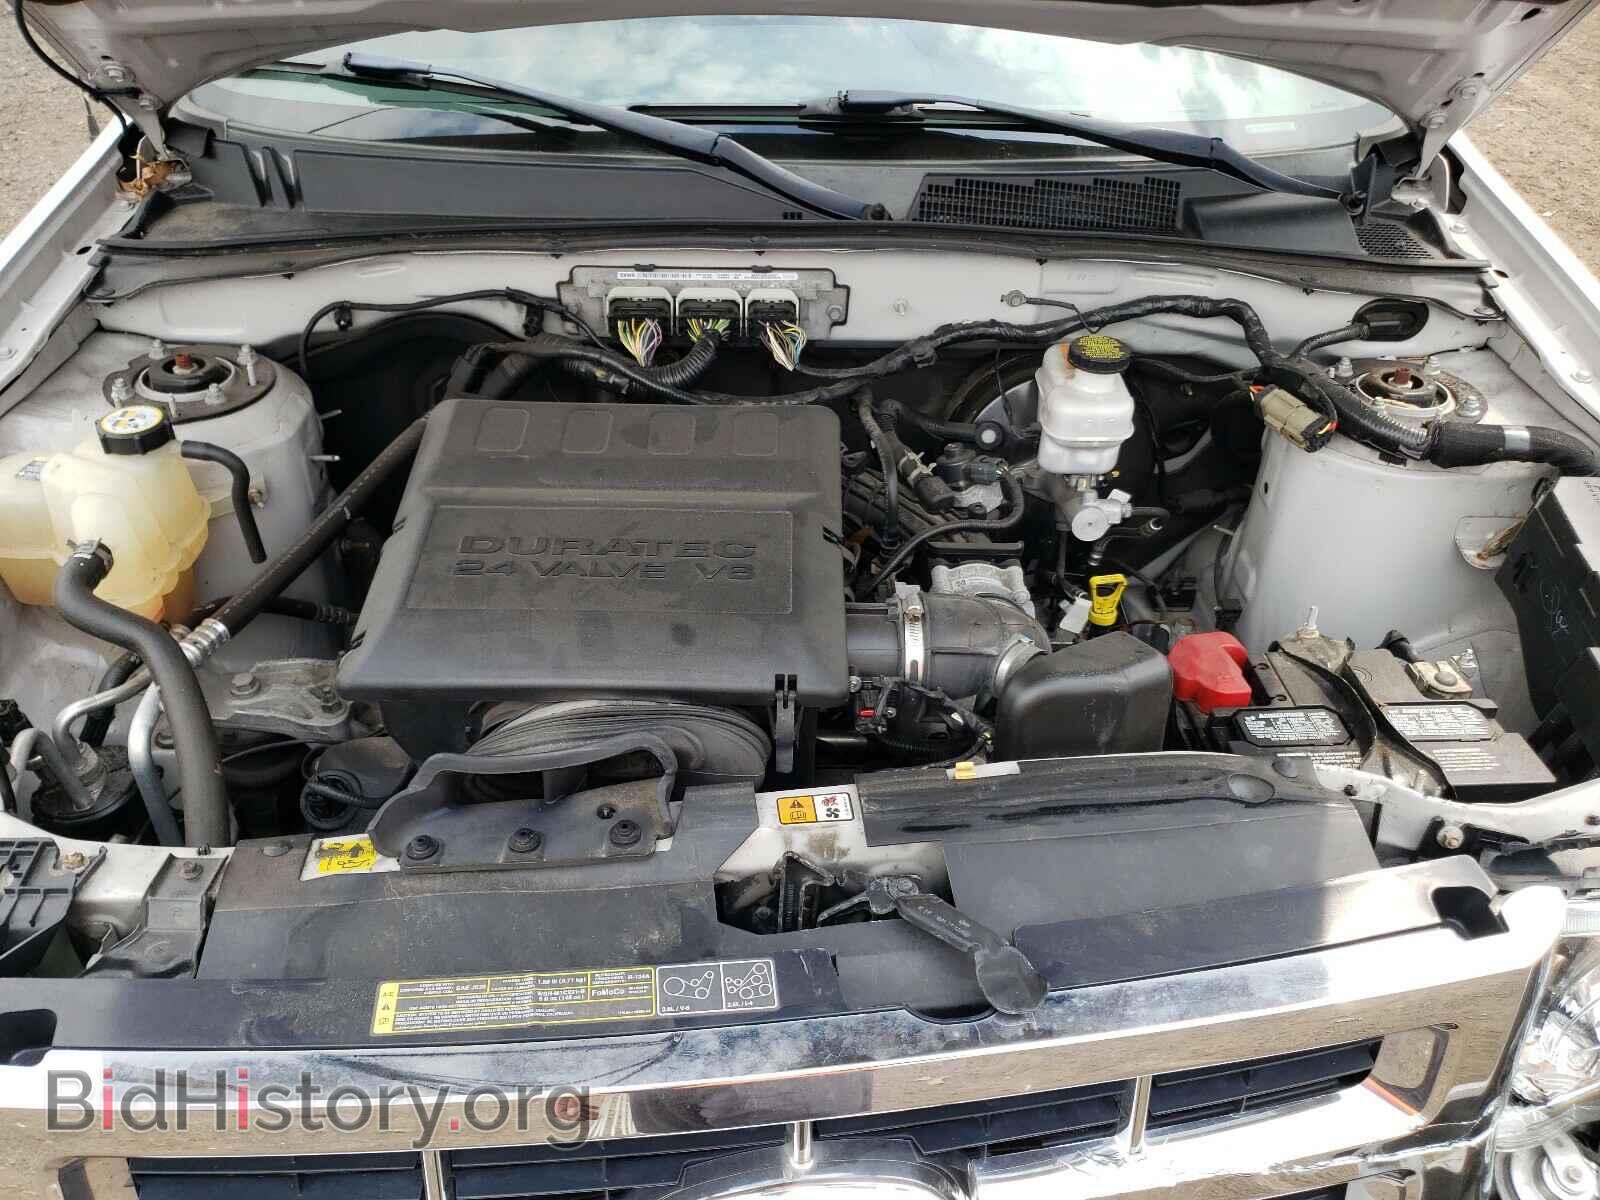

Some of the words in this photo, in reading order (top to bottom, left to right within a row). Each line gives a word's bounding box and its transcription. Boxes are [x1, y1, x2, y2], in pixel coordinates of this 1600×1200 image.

[458, 536, 757, 558] DURATEC
[453, 560, 515, 576] 24
[530, 560, 666, 579] VALVE
[696, 562, 754, 580] V6
[591, 987, 625, 997] FoMoCo
